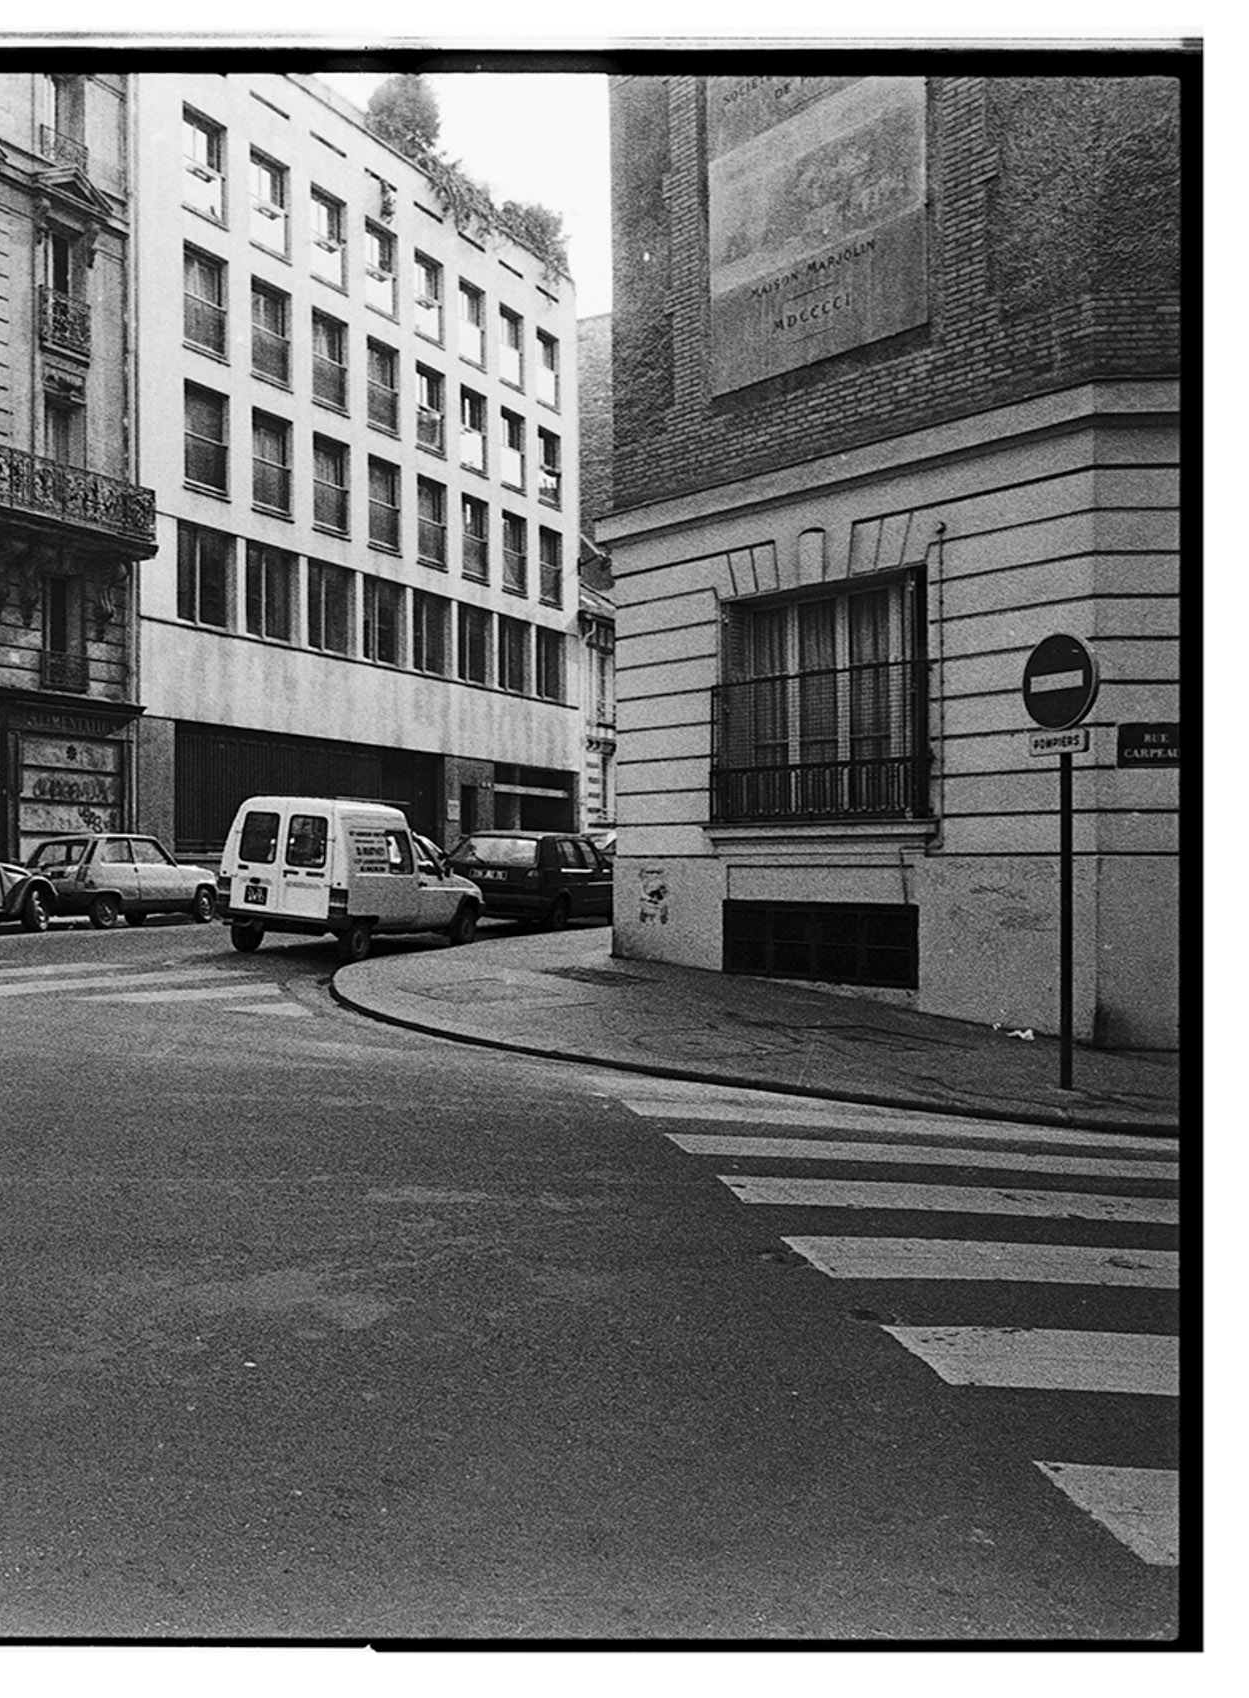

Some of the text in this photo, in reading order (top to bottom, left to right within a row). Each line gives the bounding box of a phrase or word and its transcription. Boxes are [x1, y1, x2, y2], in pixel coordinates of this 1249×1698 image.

[751, 239, 875, 298] MAISON MARJOLIN
[772, 293, 851, 334] MDCCCCI
[1033, 734, 1080, 749] POMPIERS
[1143, 733, 1170, 744] RUE
